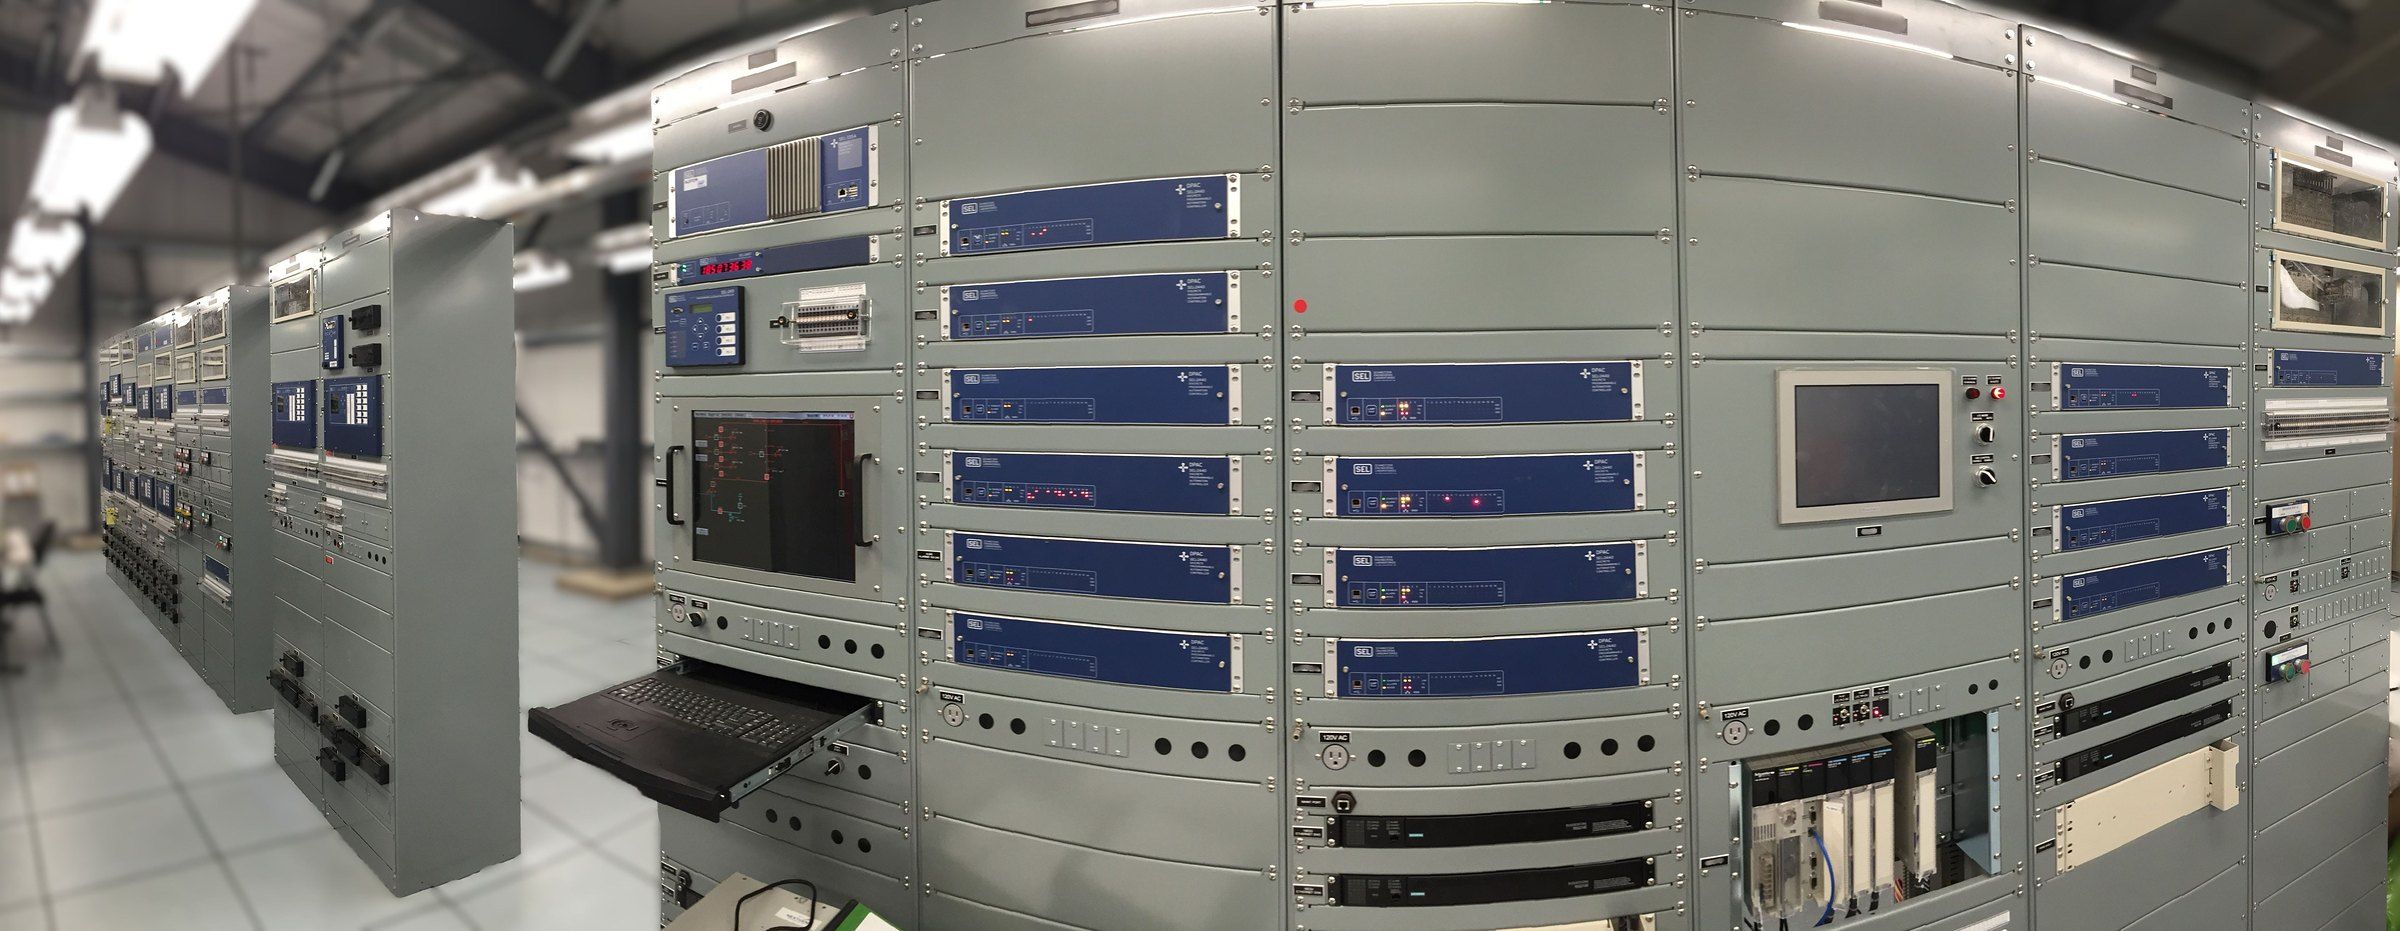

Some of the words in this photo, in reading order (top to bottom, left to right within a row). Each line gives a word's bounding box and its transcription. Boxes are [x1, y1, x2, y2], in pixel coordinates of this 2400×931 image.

[1354, 372, 1369, 380] SEL
[1355, 465, 1370, 473] SEL
[1355, 557, 1370, 565] SEL
[1356, 648, 1371, 656] SEL
